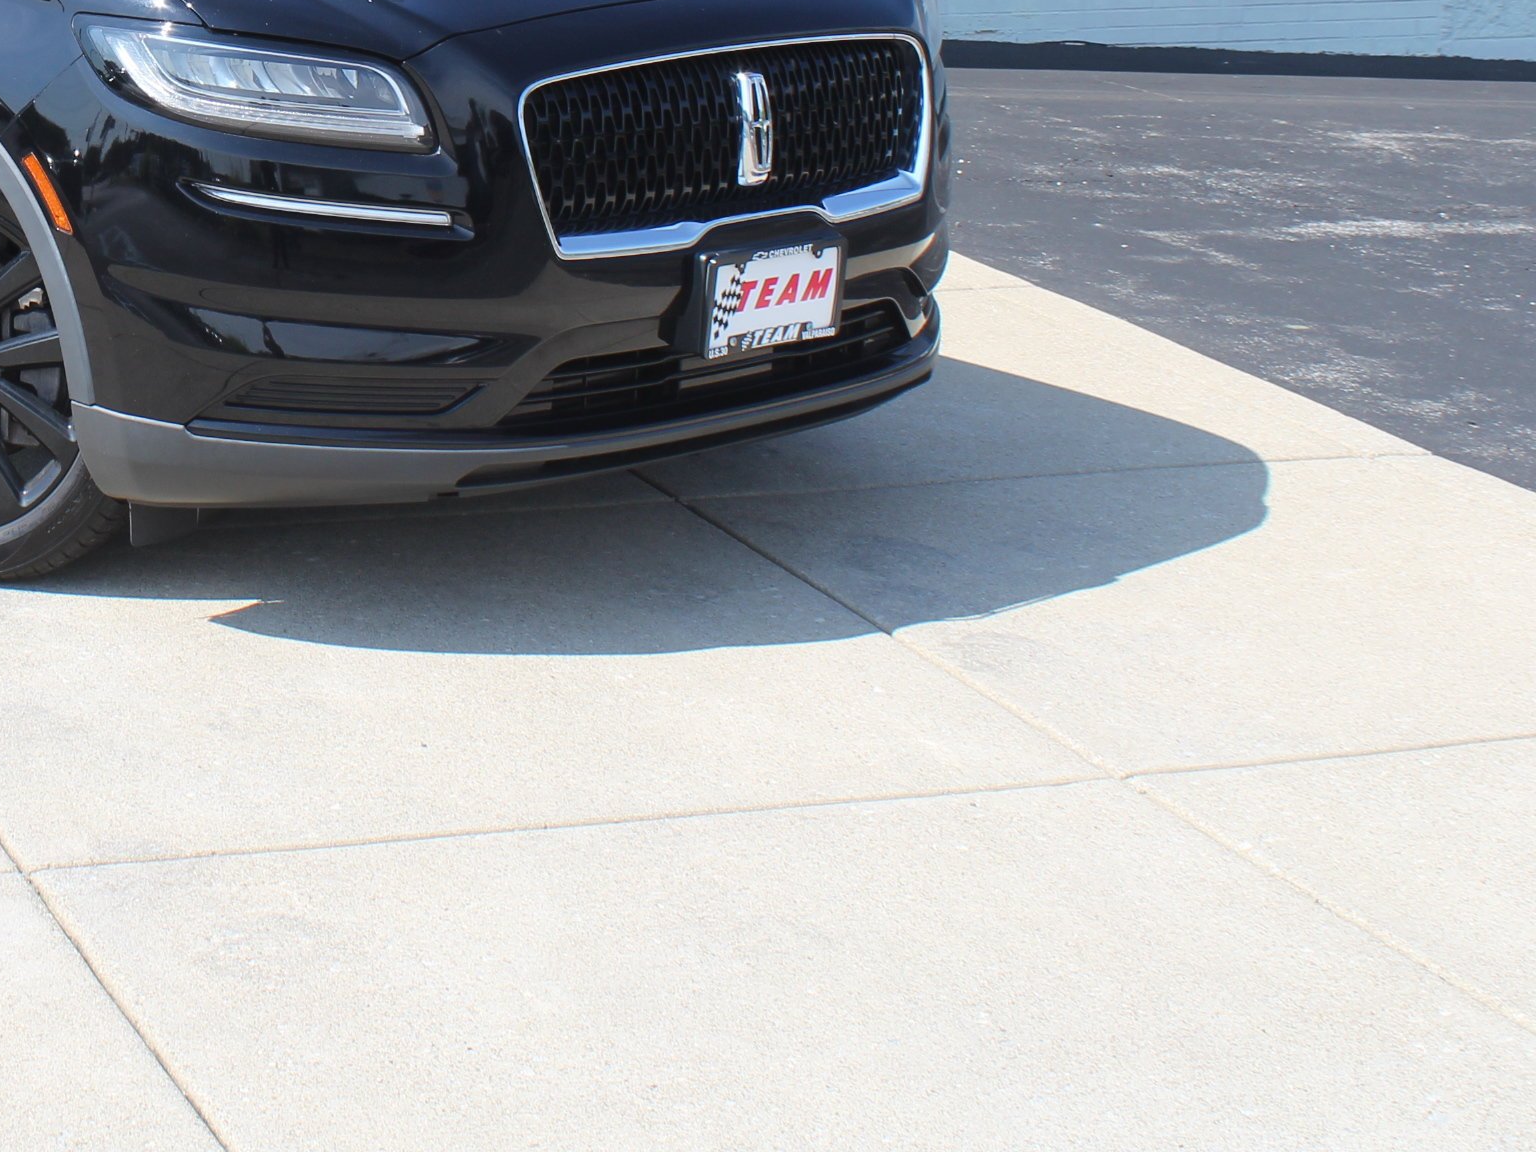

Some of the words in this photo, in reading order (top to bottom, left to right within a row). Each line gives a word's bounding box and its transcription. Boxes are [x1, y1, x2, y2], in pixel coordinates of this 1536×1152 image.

[768, 243, 814, 259] CHEVROLET
[736, 267, 834, 313] TEAM
[751, 323, 802, 349] TEAM
